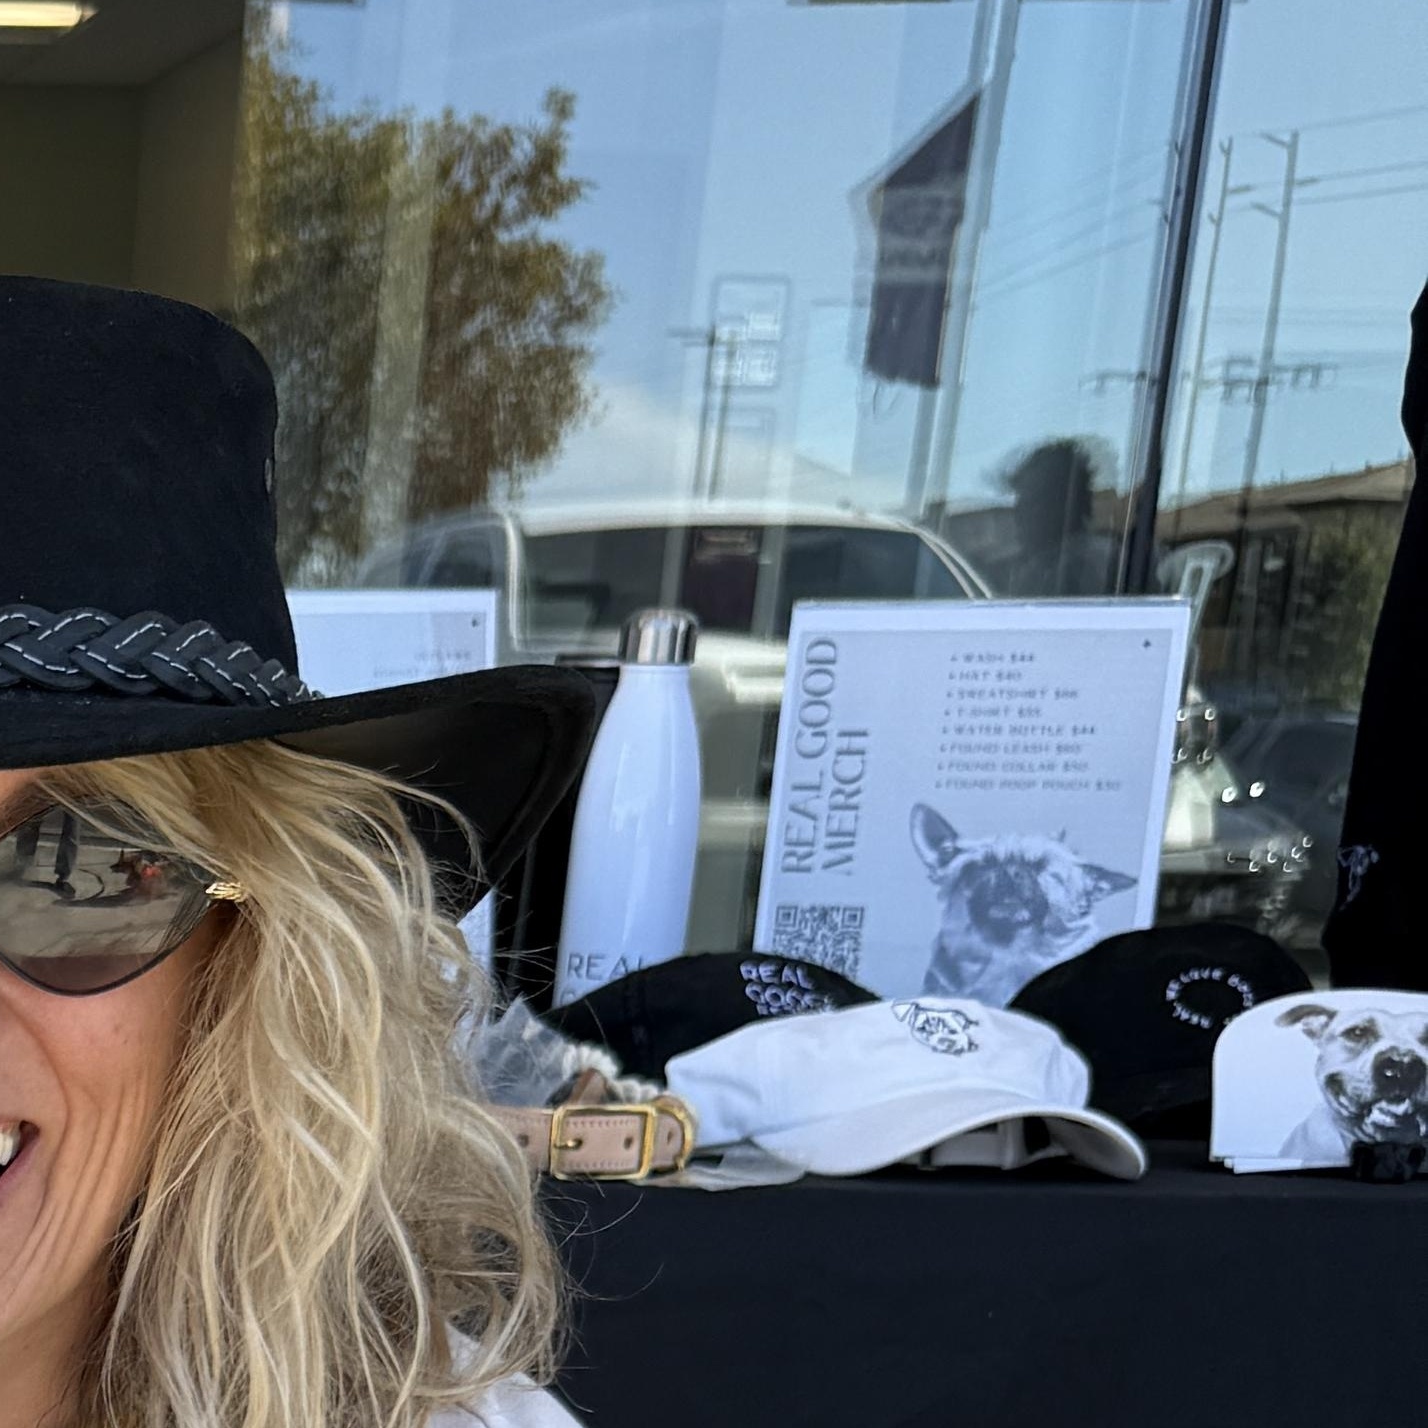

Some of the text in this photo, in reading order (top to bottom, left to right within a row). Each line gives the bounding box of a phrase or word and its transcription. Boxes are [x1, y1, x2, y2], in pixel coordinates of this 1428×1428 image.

[781, 637, 838, 874] REAL GOOD
[821, 728, 870, 877] MERCH
[739, 960, 815, 990] REAL
